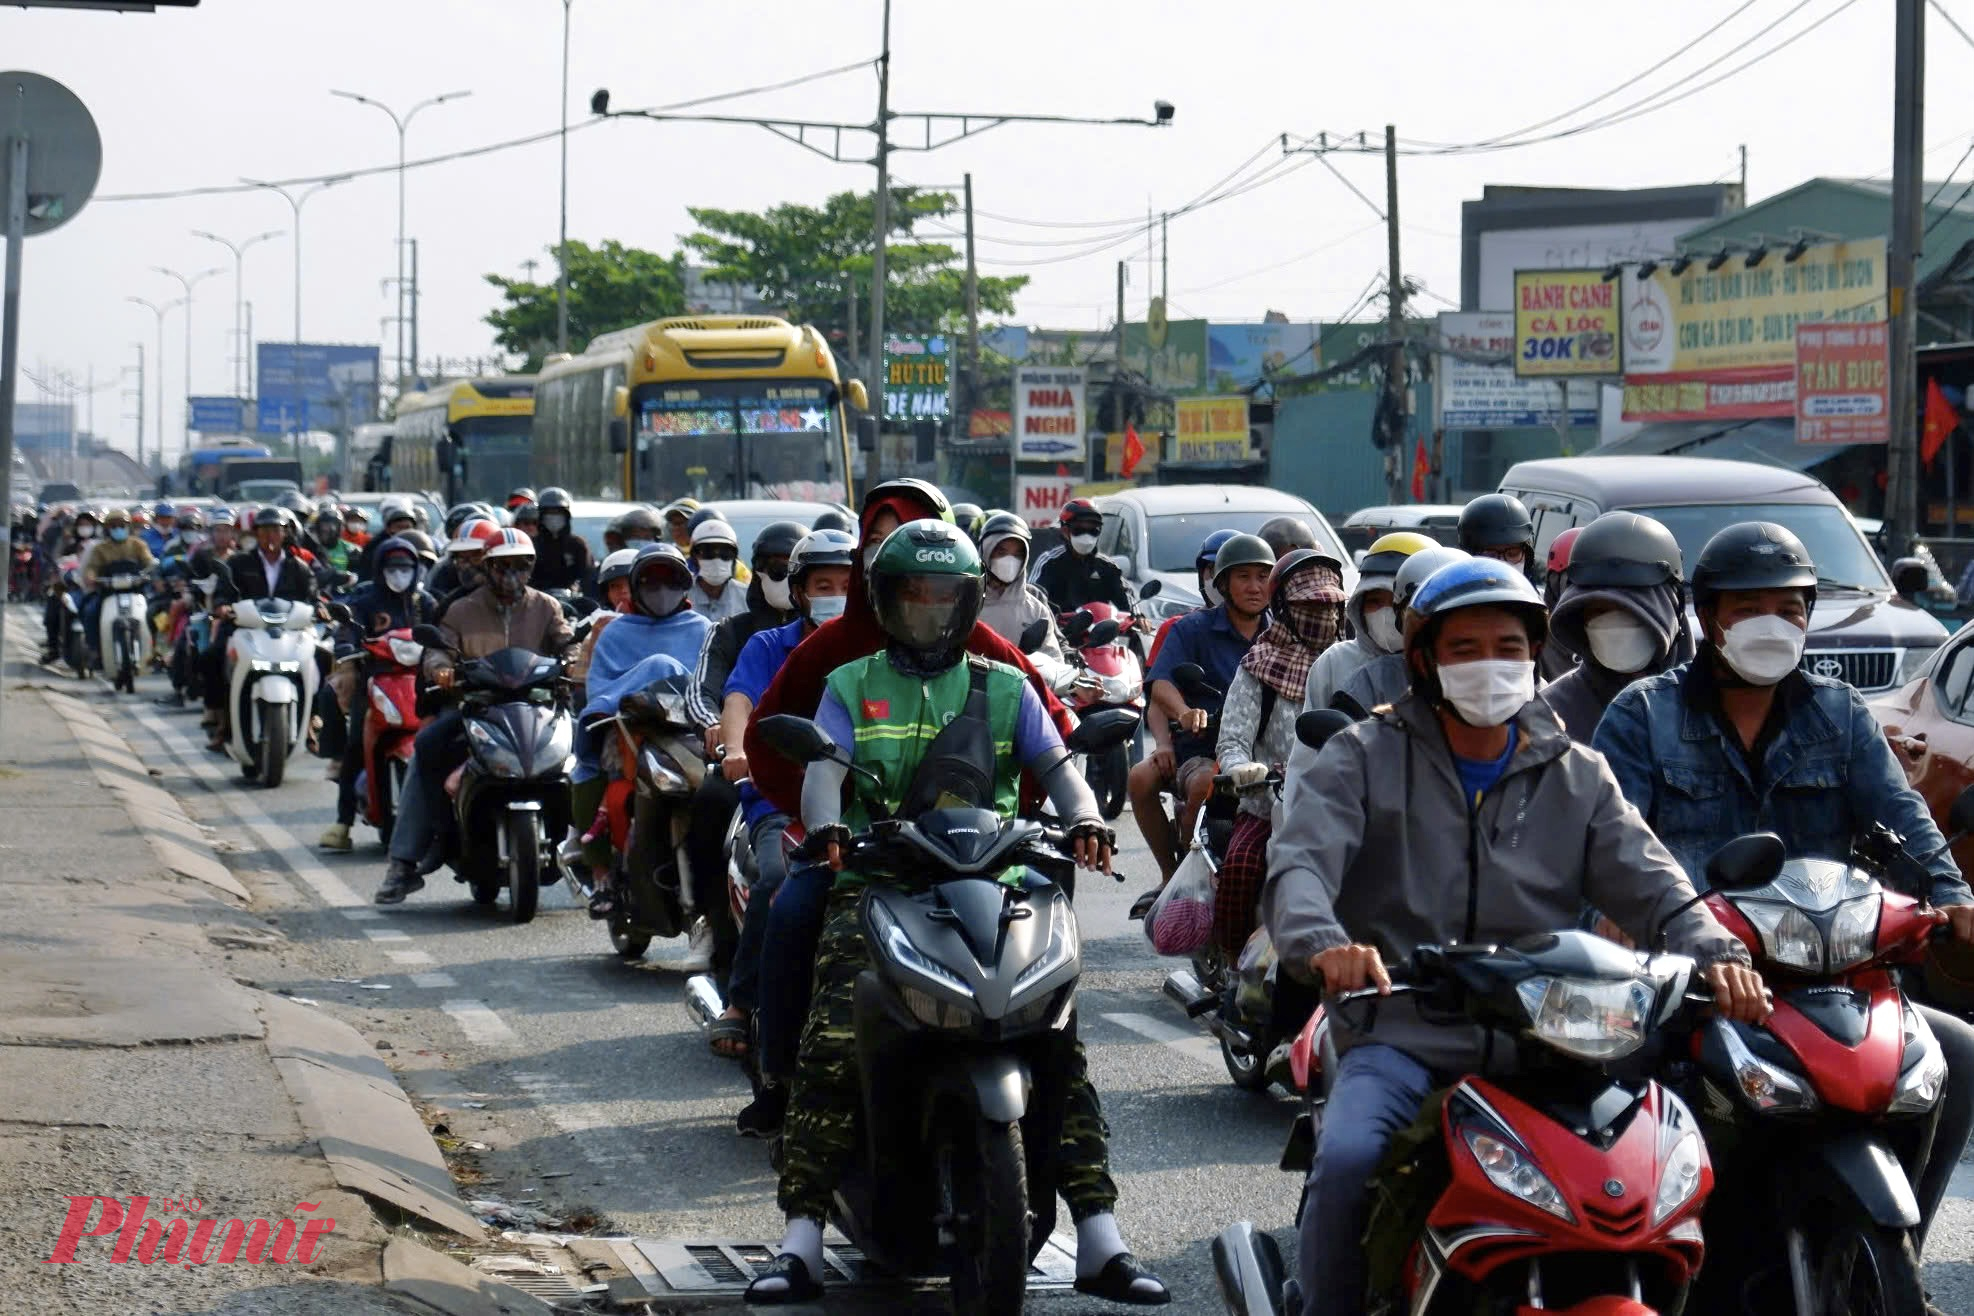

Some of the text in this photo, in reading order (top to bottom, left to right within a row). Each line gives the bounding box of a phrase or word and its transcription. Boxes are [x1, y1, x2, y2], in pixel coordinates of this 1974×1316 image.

[1522, 277, 1613, 310] BÁNH CANH
[1523, 337, 1574, 360] 30K
[1029, 386, 1074, 407] NHÀ
[916, 548, 956, 564] Grab
[947, 827, 980, 835] HONDA
[1808, 985, 1855, 995] HONDA
